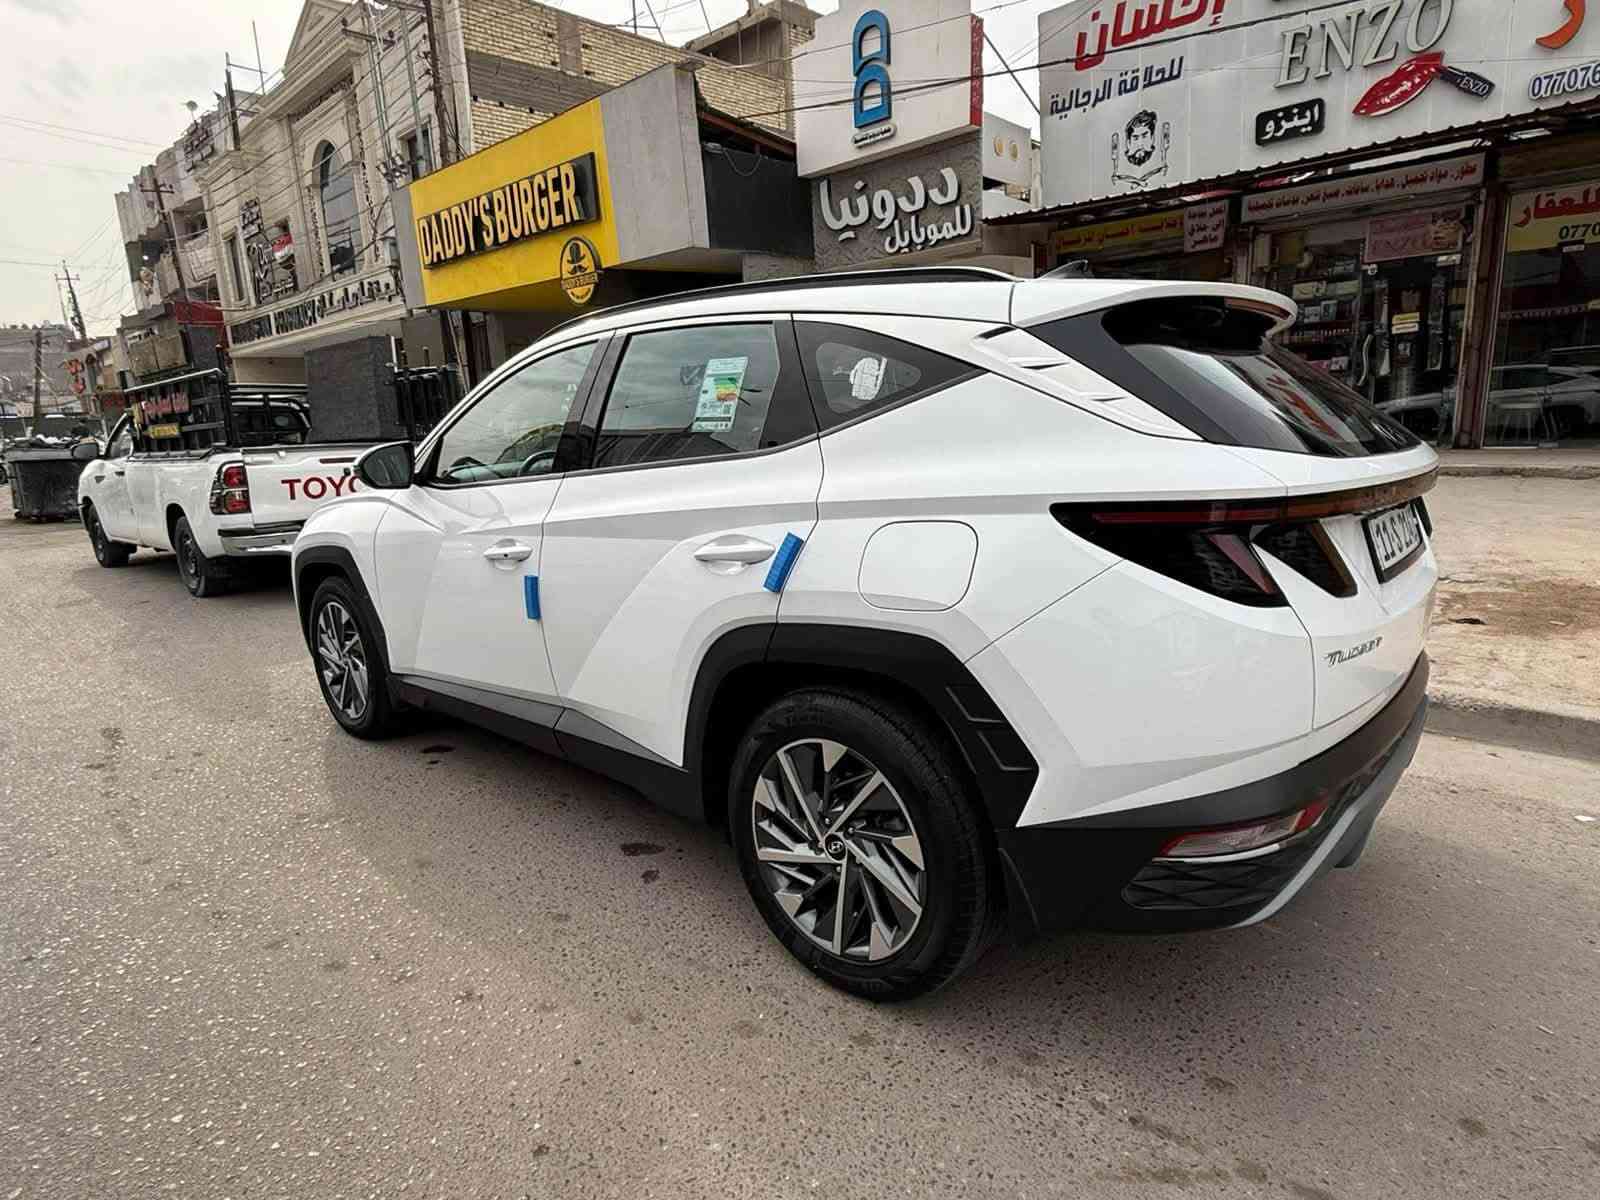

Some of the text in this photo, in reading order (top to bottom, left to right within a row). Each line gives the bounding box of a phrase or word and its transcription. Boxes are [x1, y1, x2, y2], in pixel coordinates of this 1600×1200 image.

[1274, 0, 1453, 88] ENZO
[1050, 56, 1184, 120] للحلاقة الرجالية
[1460, 76, 1489, 96] ENZO
[1529, 62, 1600, 99] 077076
[1261, 103, 1320, 140] اينزو
[420, 163, 580, 265] DADDY'S BURGER
[819, 167, 961, 241] ددونيا
[884, 203, 973, 254] للموبايل
[1559, 222, 1600, 240] 0770
